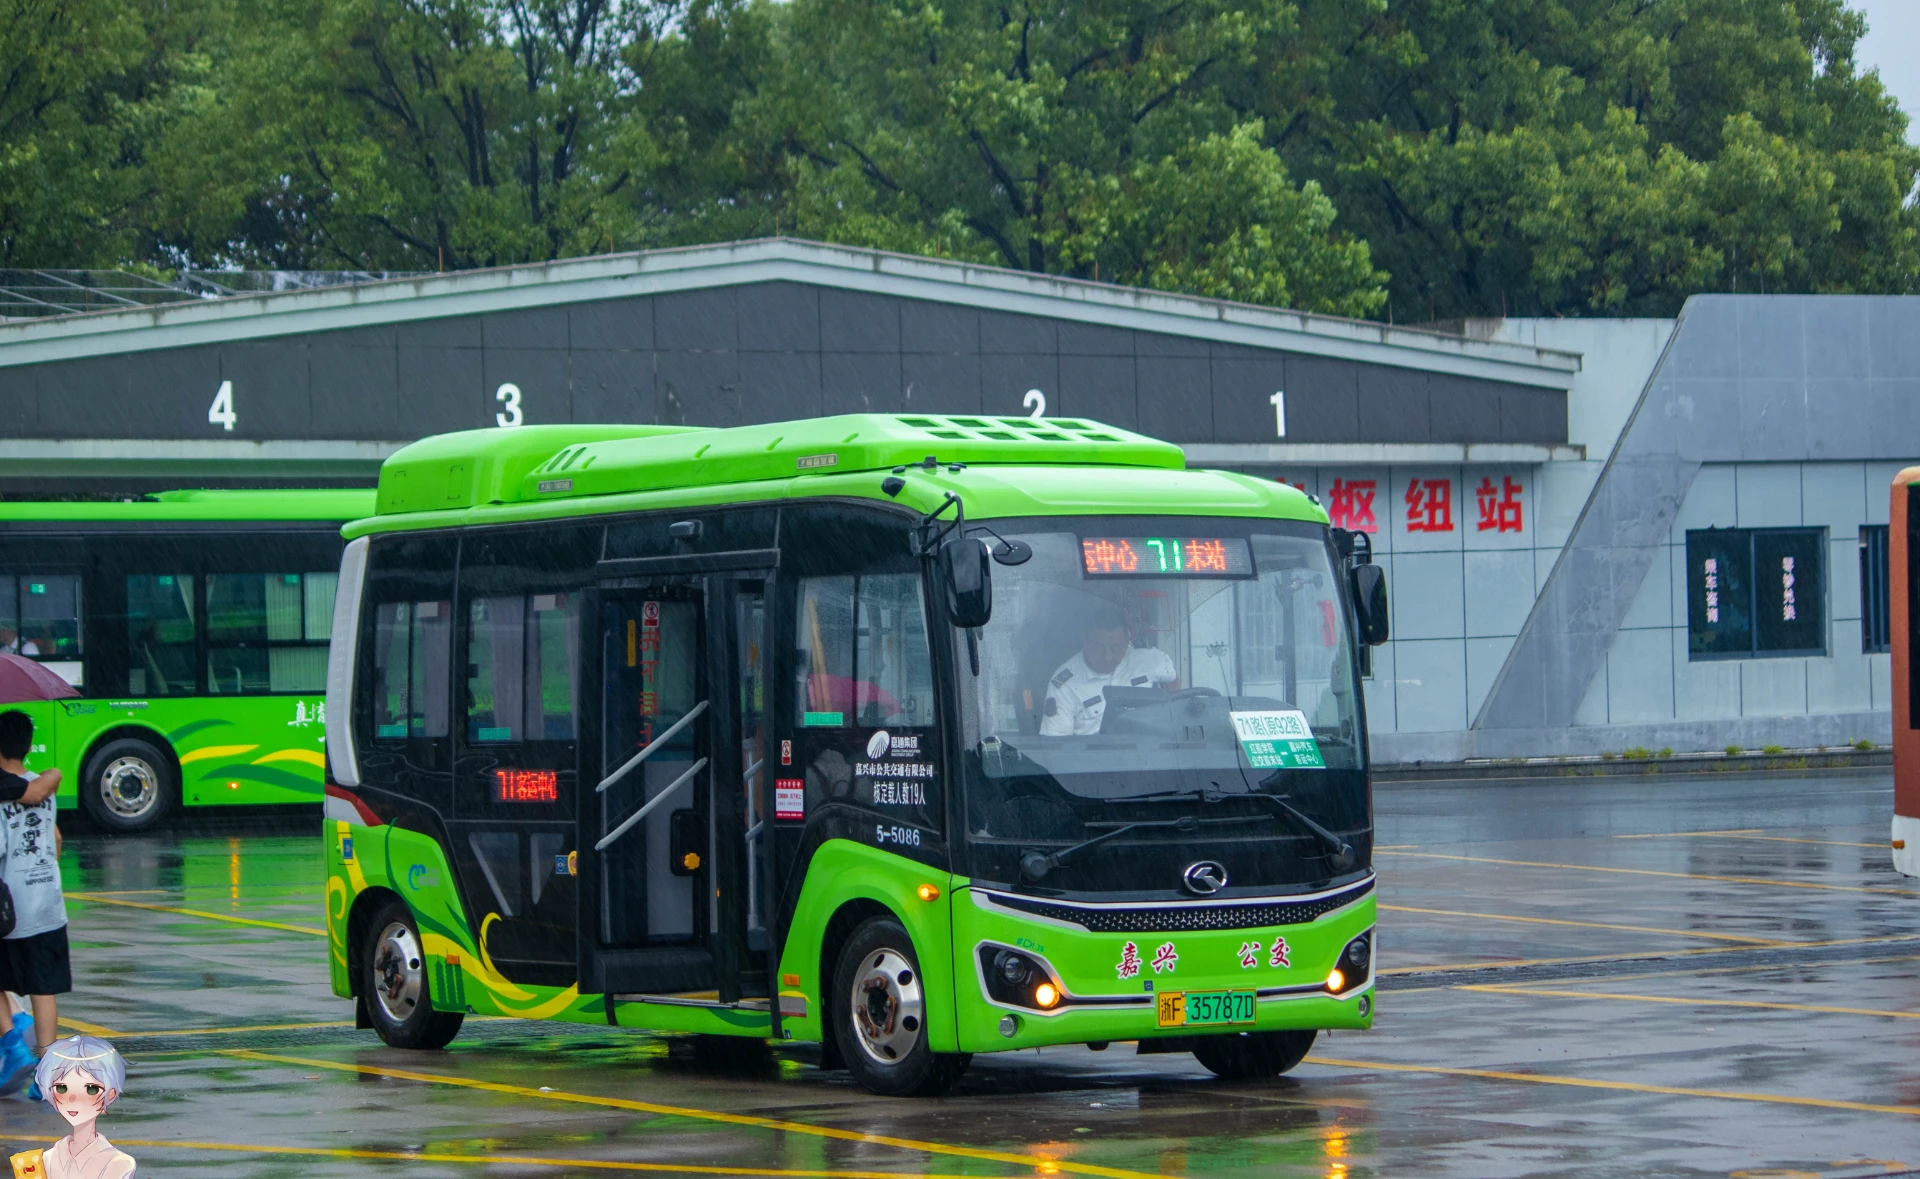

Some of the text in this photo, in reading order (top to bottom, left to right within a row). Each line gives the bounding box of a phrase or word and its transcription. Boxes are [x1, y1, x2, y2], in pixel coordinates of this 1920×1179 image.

[208, 381, 236, 431] 4
[496, 383, 523, 427] 3
[1023, 389, 1046, 418] 2
[1270, 391, 1286, 437] 1
[1275, 475, 1523, 533] 枢纽站
[1146, 537, 1182, 572] 71
[1185, 540, 1227, 571] 末站
[855, 762, 933, 777] 嘉兴市公共交通有限公司
[873, 781, 926, 805] 核定载人数19人
[876, 824, 920, 846] 5-5086
[1115, 936, 1291, 979] 嘉兴 公交
[1190, 994, 1254, 1020] 35787D
